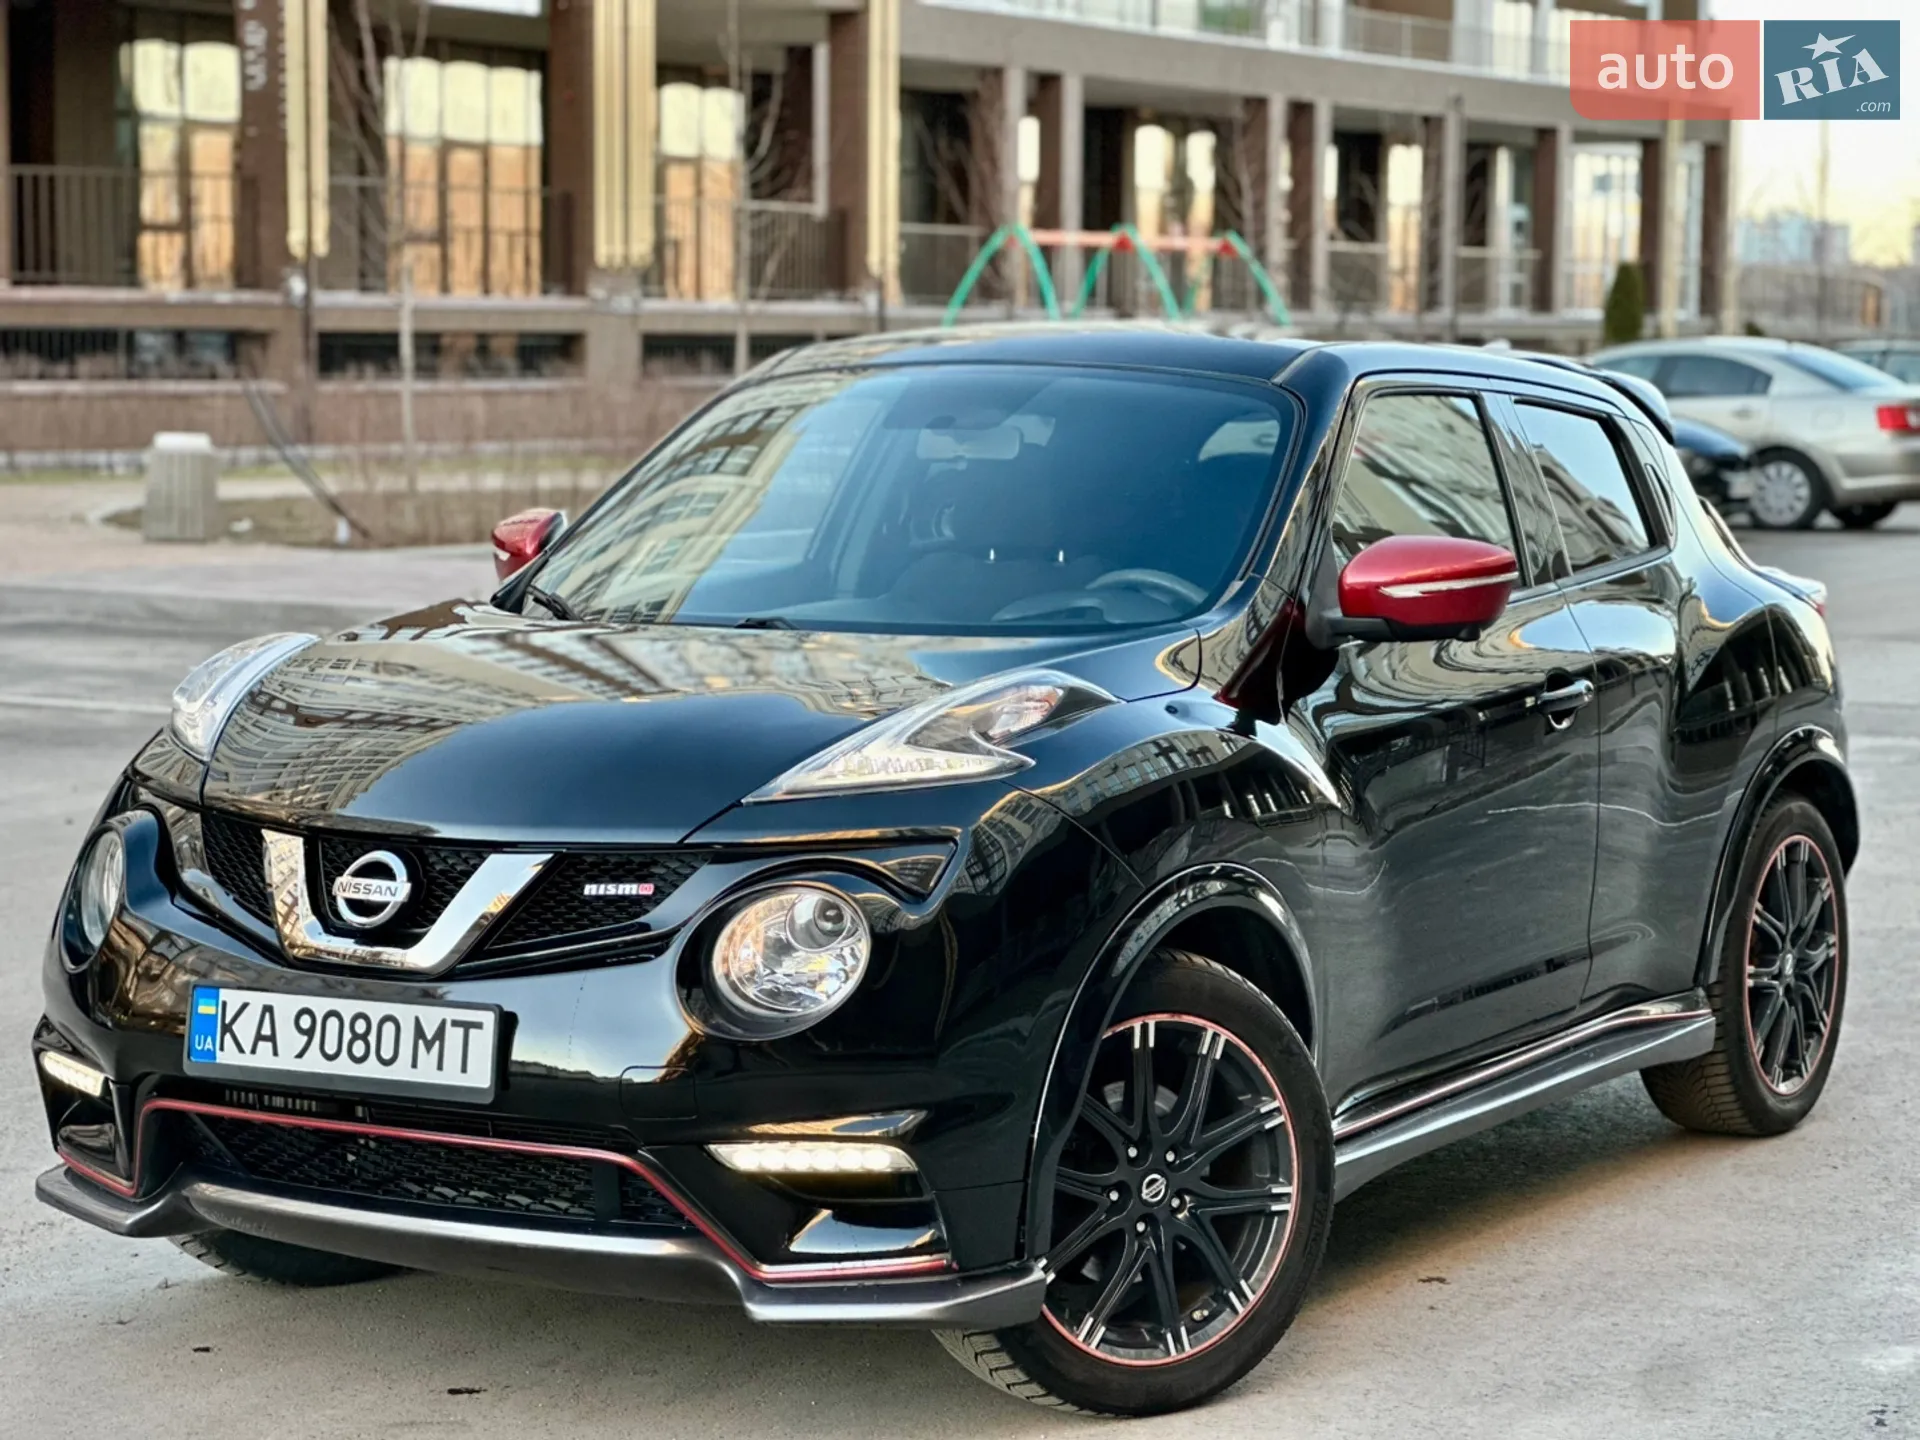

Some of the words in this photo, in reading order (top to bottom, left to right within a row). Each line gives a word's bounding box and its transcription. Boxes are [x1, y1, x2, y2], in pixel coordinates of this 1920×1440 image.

[337, 881, 399, 897] NISSAN
[195, 1035, 214, 1052] UA
[218, 999, 279, 1057] KA
[294, 1006, 401, 1067] 9080
[410, 1015, 484, 1074] MT
